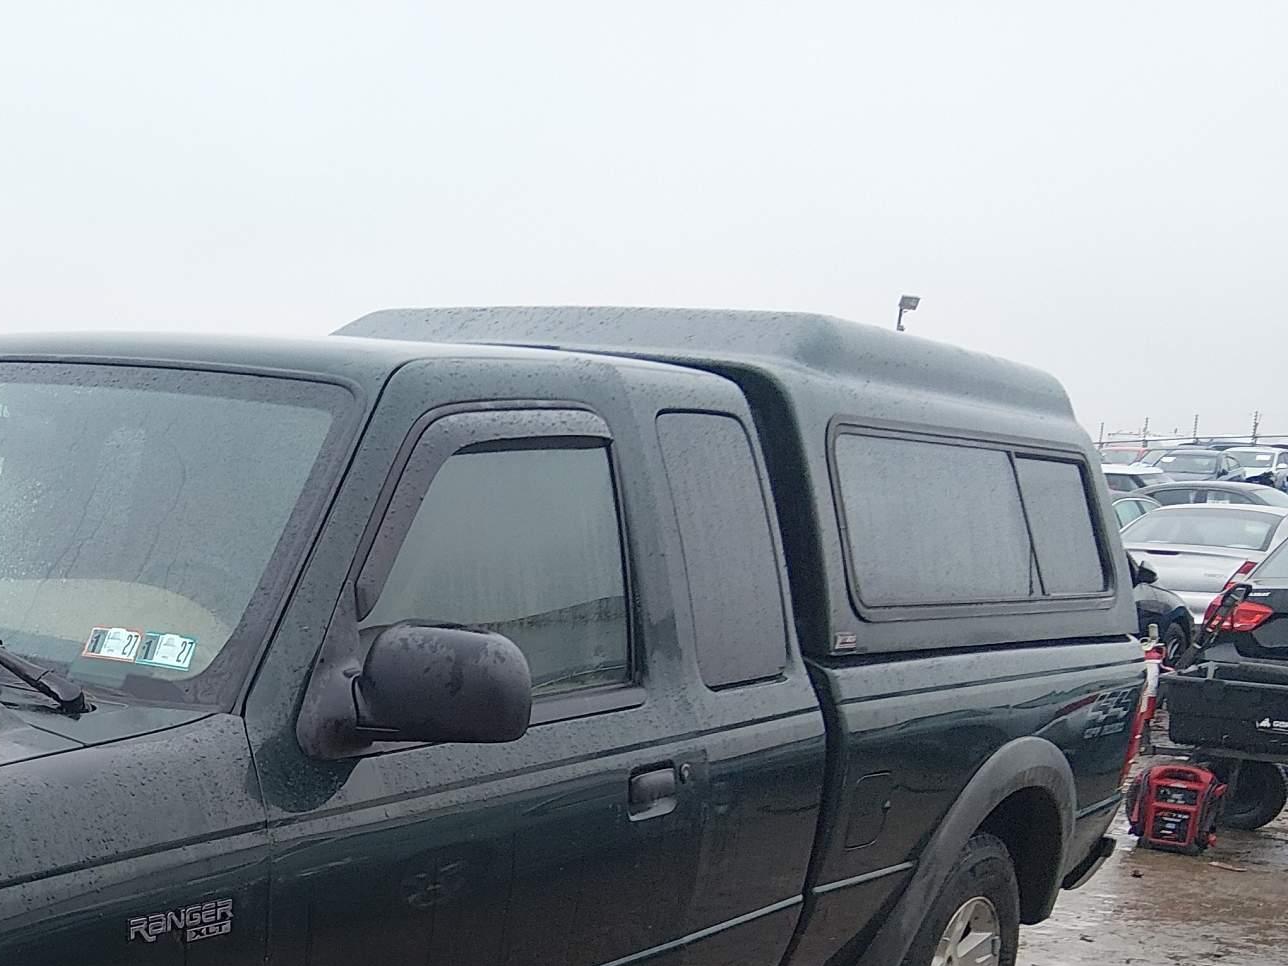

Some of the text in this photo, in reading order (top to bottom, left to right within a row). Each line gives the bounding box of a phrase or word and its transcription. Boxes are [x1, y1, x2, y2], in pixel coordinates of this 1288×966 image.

[121, 634, 140, 657] 27
[175, 640, 194, 664] 27
[128, 898, 234, 942] RANGER
[190, 921, 228, 940] XLT
